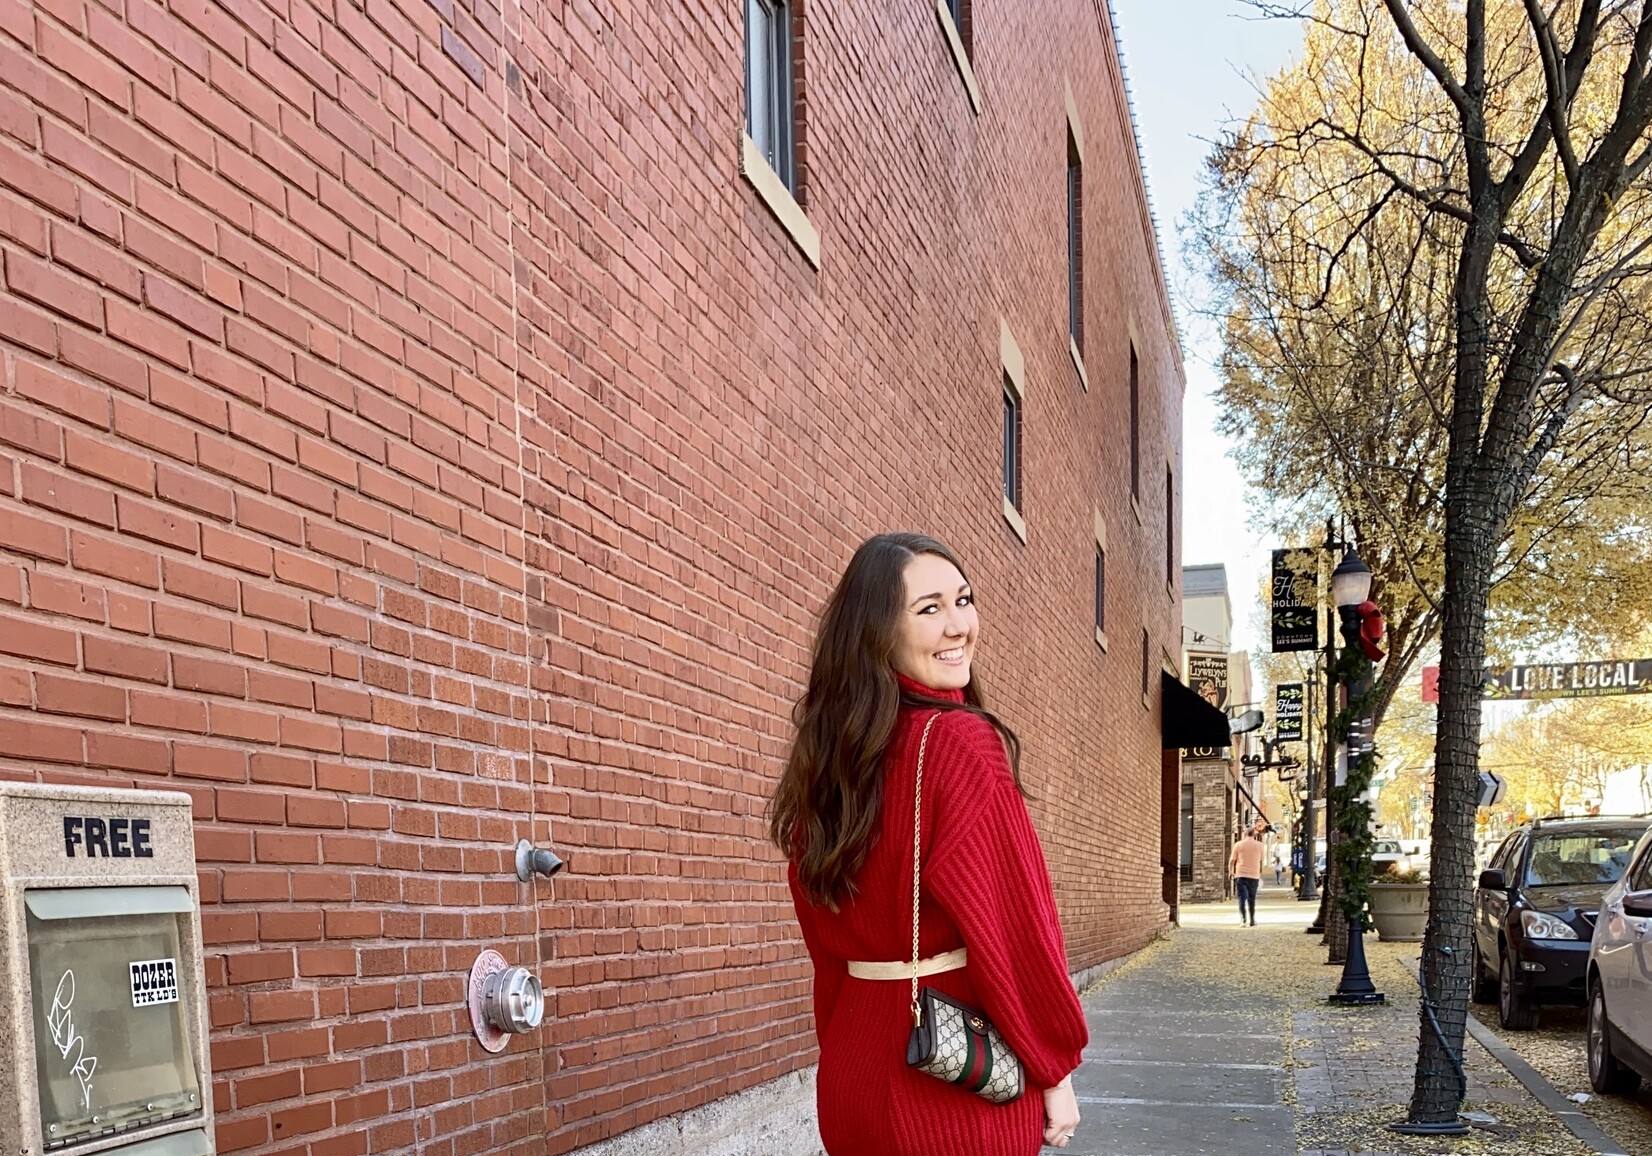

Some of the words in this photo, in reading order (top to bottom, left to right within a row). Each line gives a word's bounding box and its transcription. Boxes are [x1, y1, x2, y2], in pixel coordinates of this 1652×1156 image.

[1273, 599, 1309, 607] HOLID
[1511, 666, 1564, 691] LOVE
[1572, 662, 1640, 689] LOCAL
[1599, 687, 1627, 695] SUMMIT
[1277, 698, 1303, 713] Happy
[64, 816, 153, 857] FREE
[132, 961, 175, 991] DOZER
